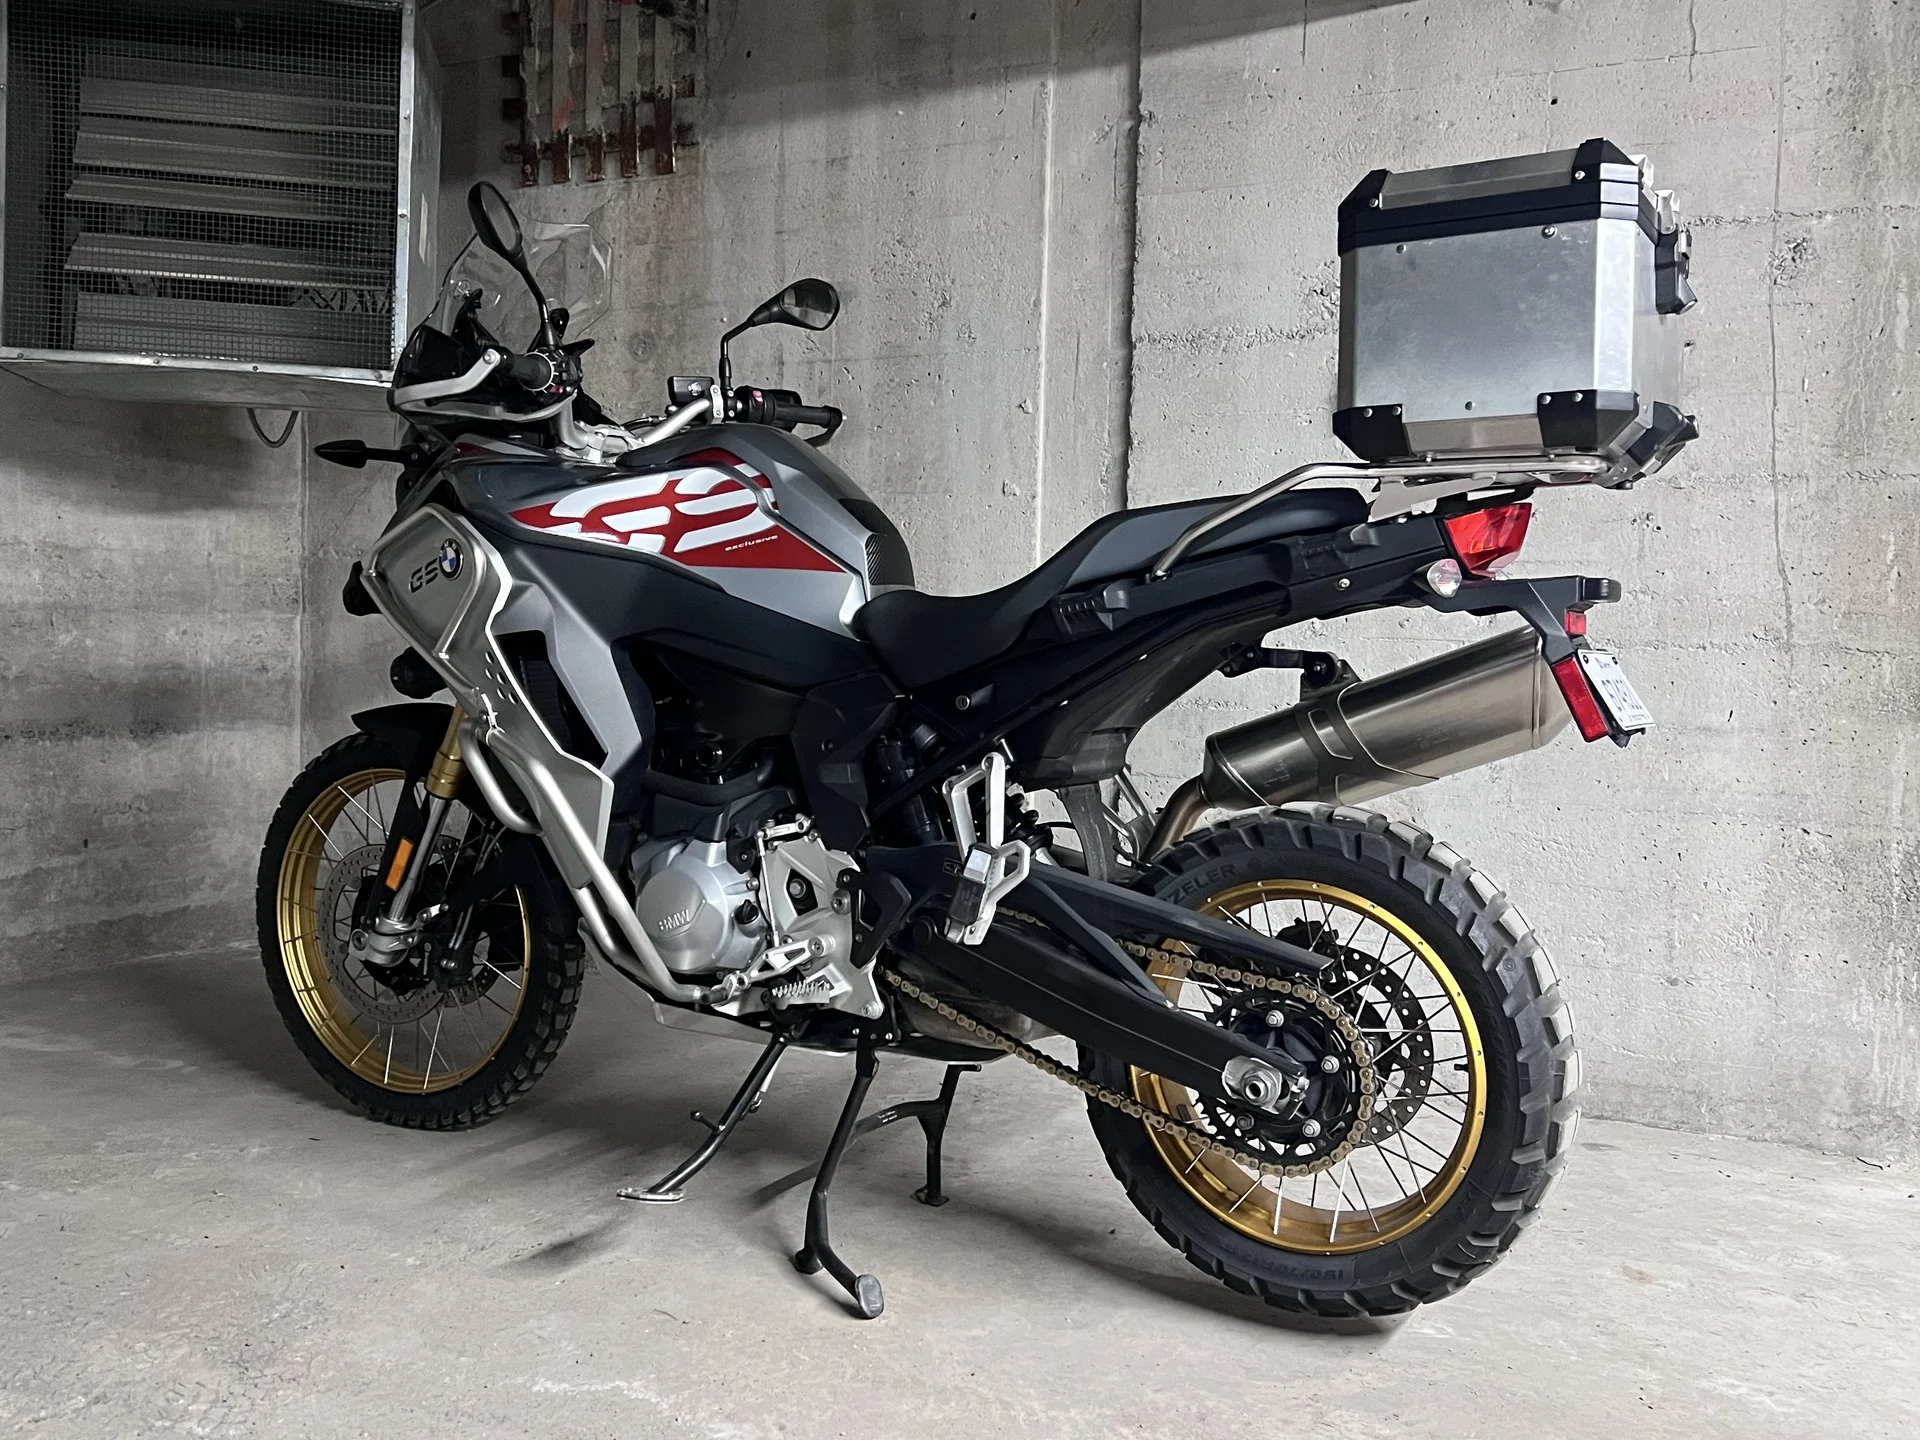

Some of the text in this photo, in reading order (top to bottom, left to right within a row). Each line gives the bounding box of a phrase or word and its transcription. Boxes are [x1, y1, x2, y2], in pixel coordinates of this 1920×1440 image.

[724, 534, 778, 552] exclusive
[409, 557, 439, 593] GS
[1164, 863, 1237, 904] ZELER
[658, 908, 690, 932] BMW
